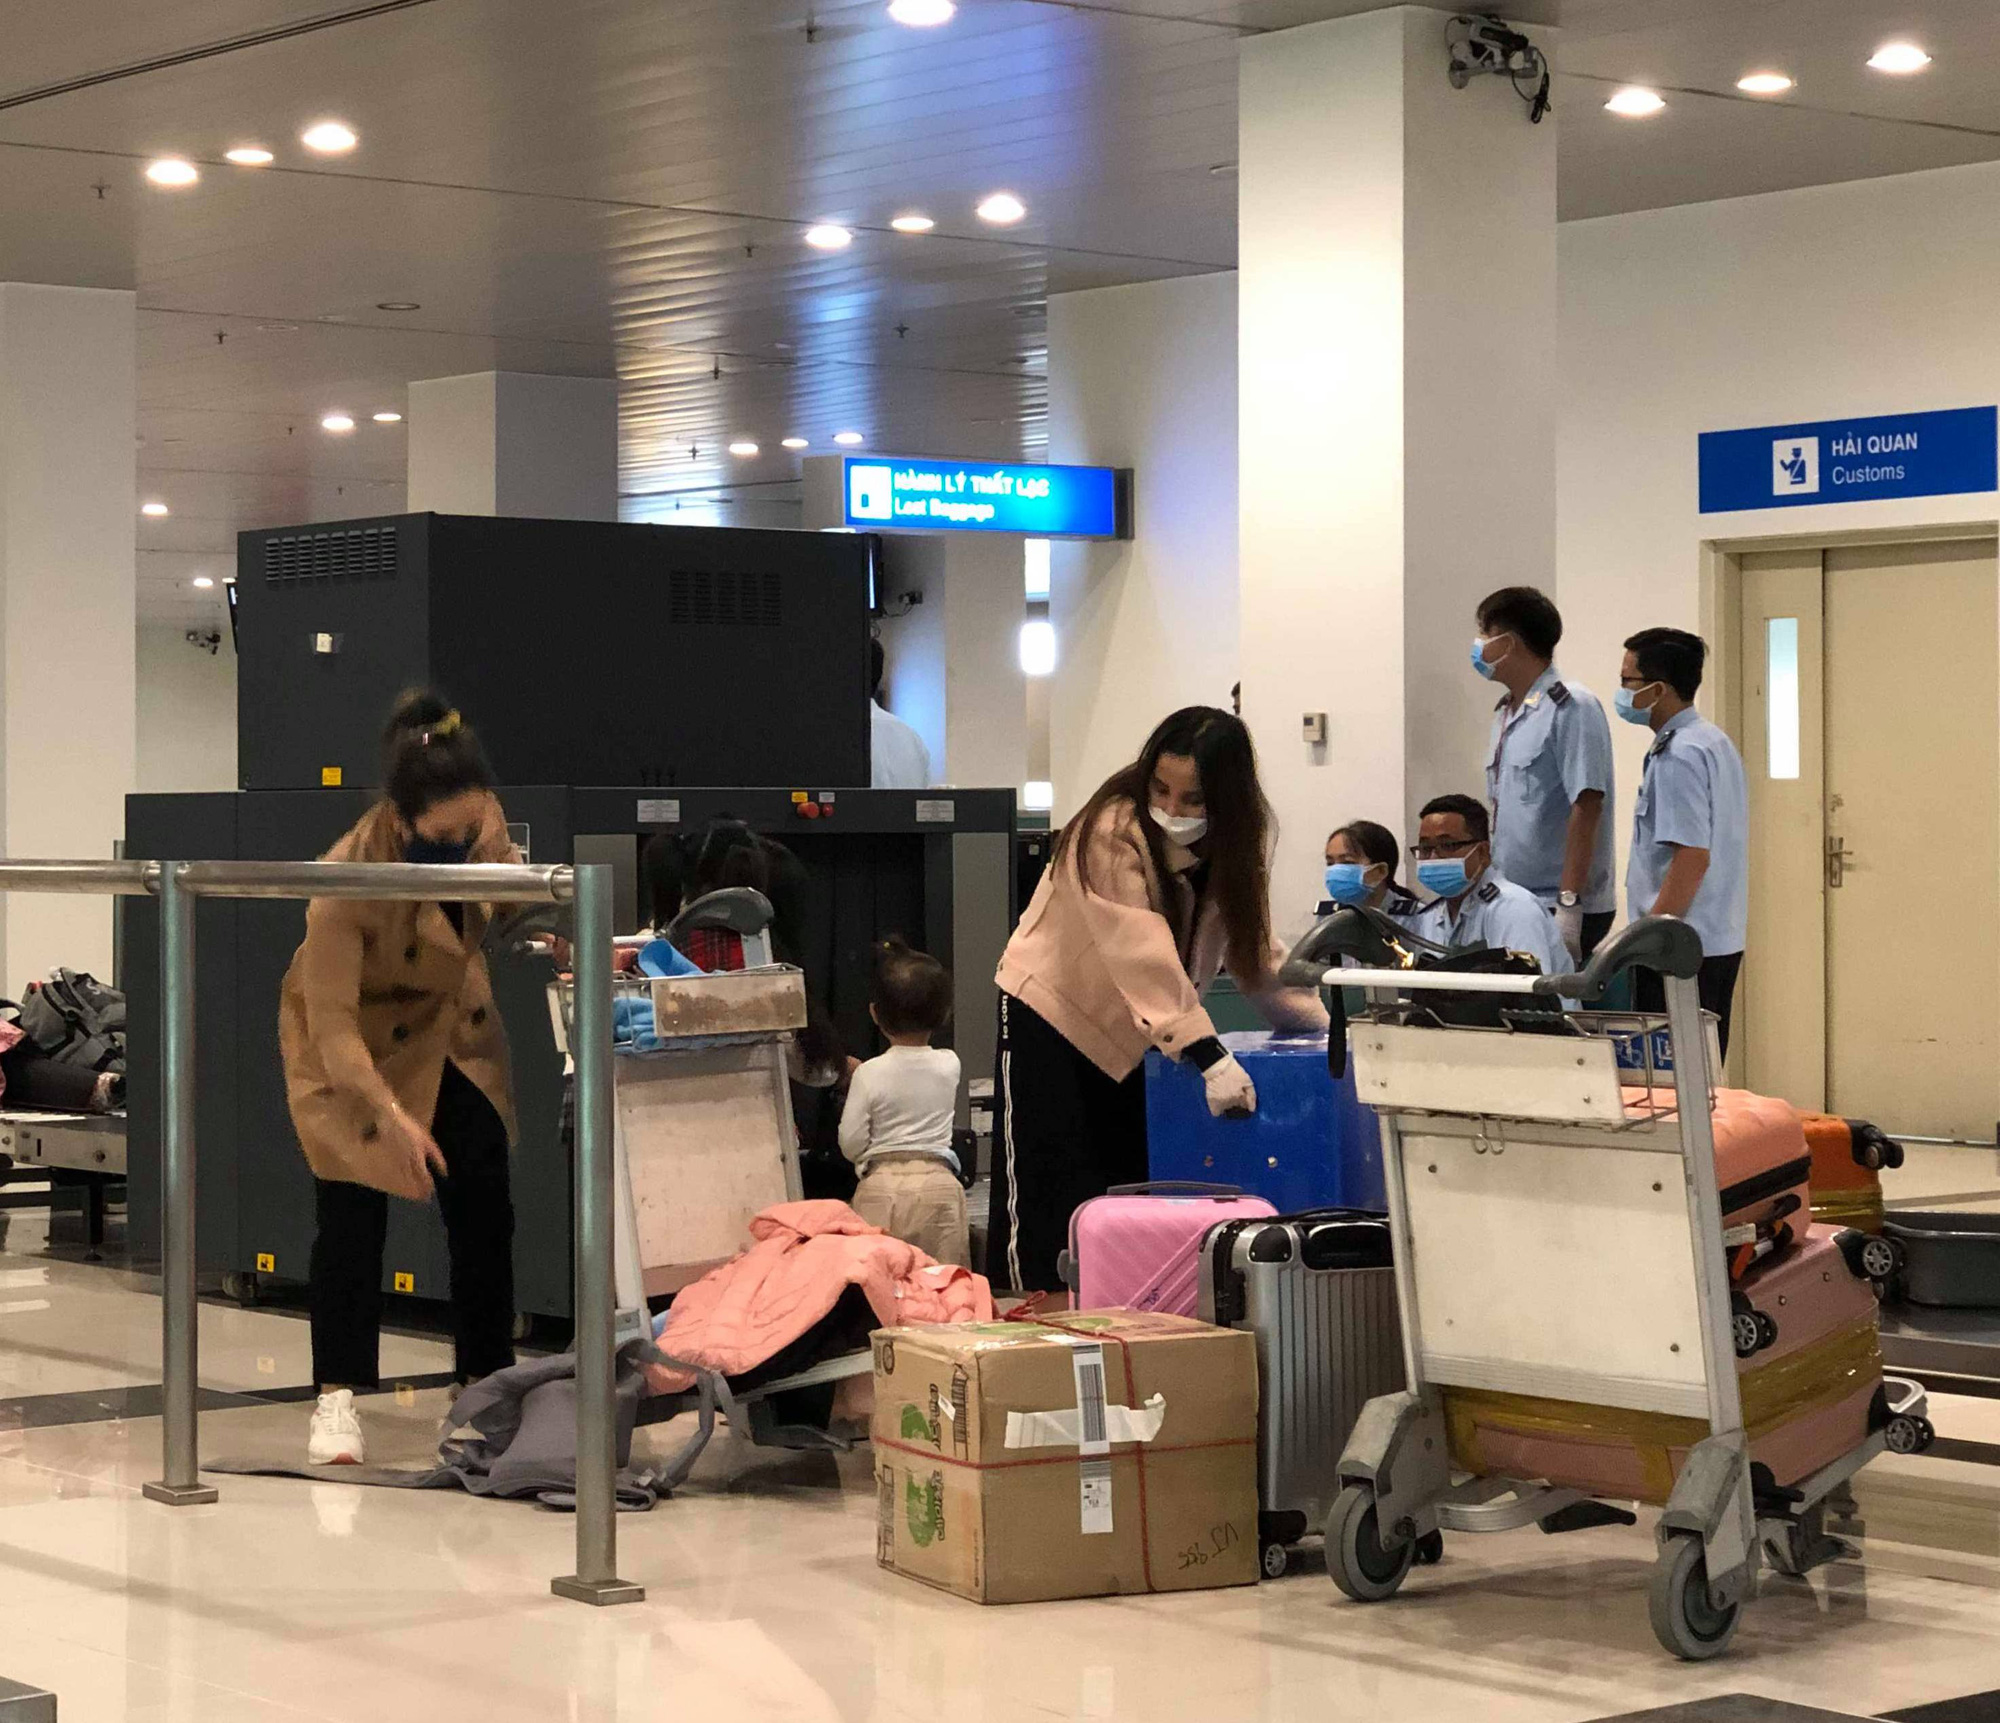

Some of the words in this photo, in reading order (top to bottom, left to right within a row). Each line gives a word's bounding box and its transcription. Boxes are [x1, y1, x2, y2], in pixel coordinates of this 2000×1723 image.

[1831, 431, 1862, 456] HẢI
[1867, 432, 1918, 454] QUAN
[945, 469, 967, 493] LÝ
[1832, 465, 1905, 485] Customs
[894, 496, 927, 516] Lost
[929, 497, 996, 523] Baggage
